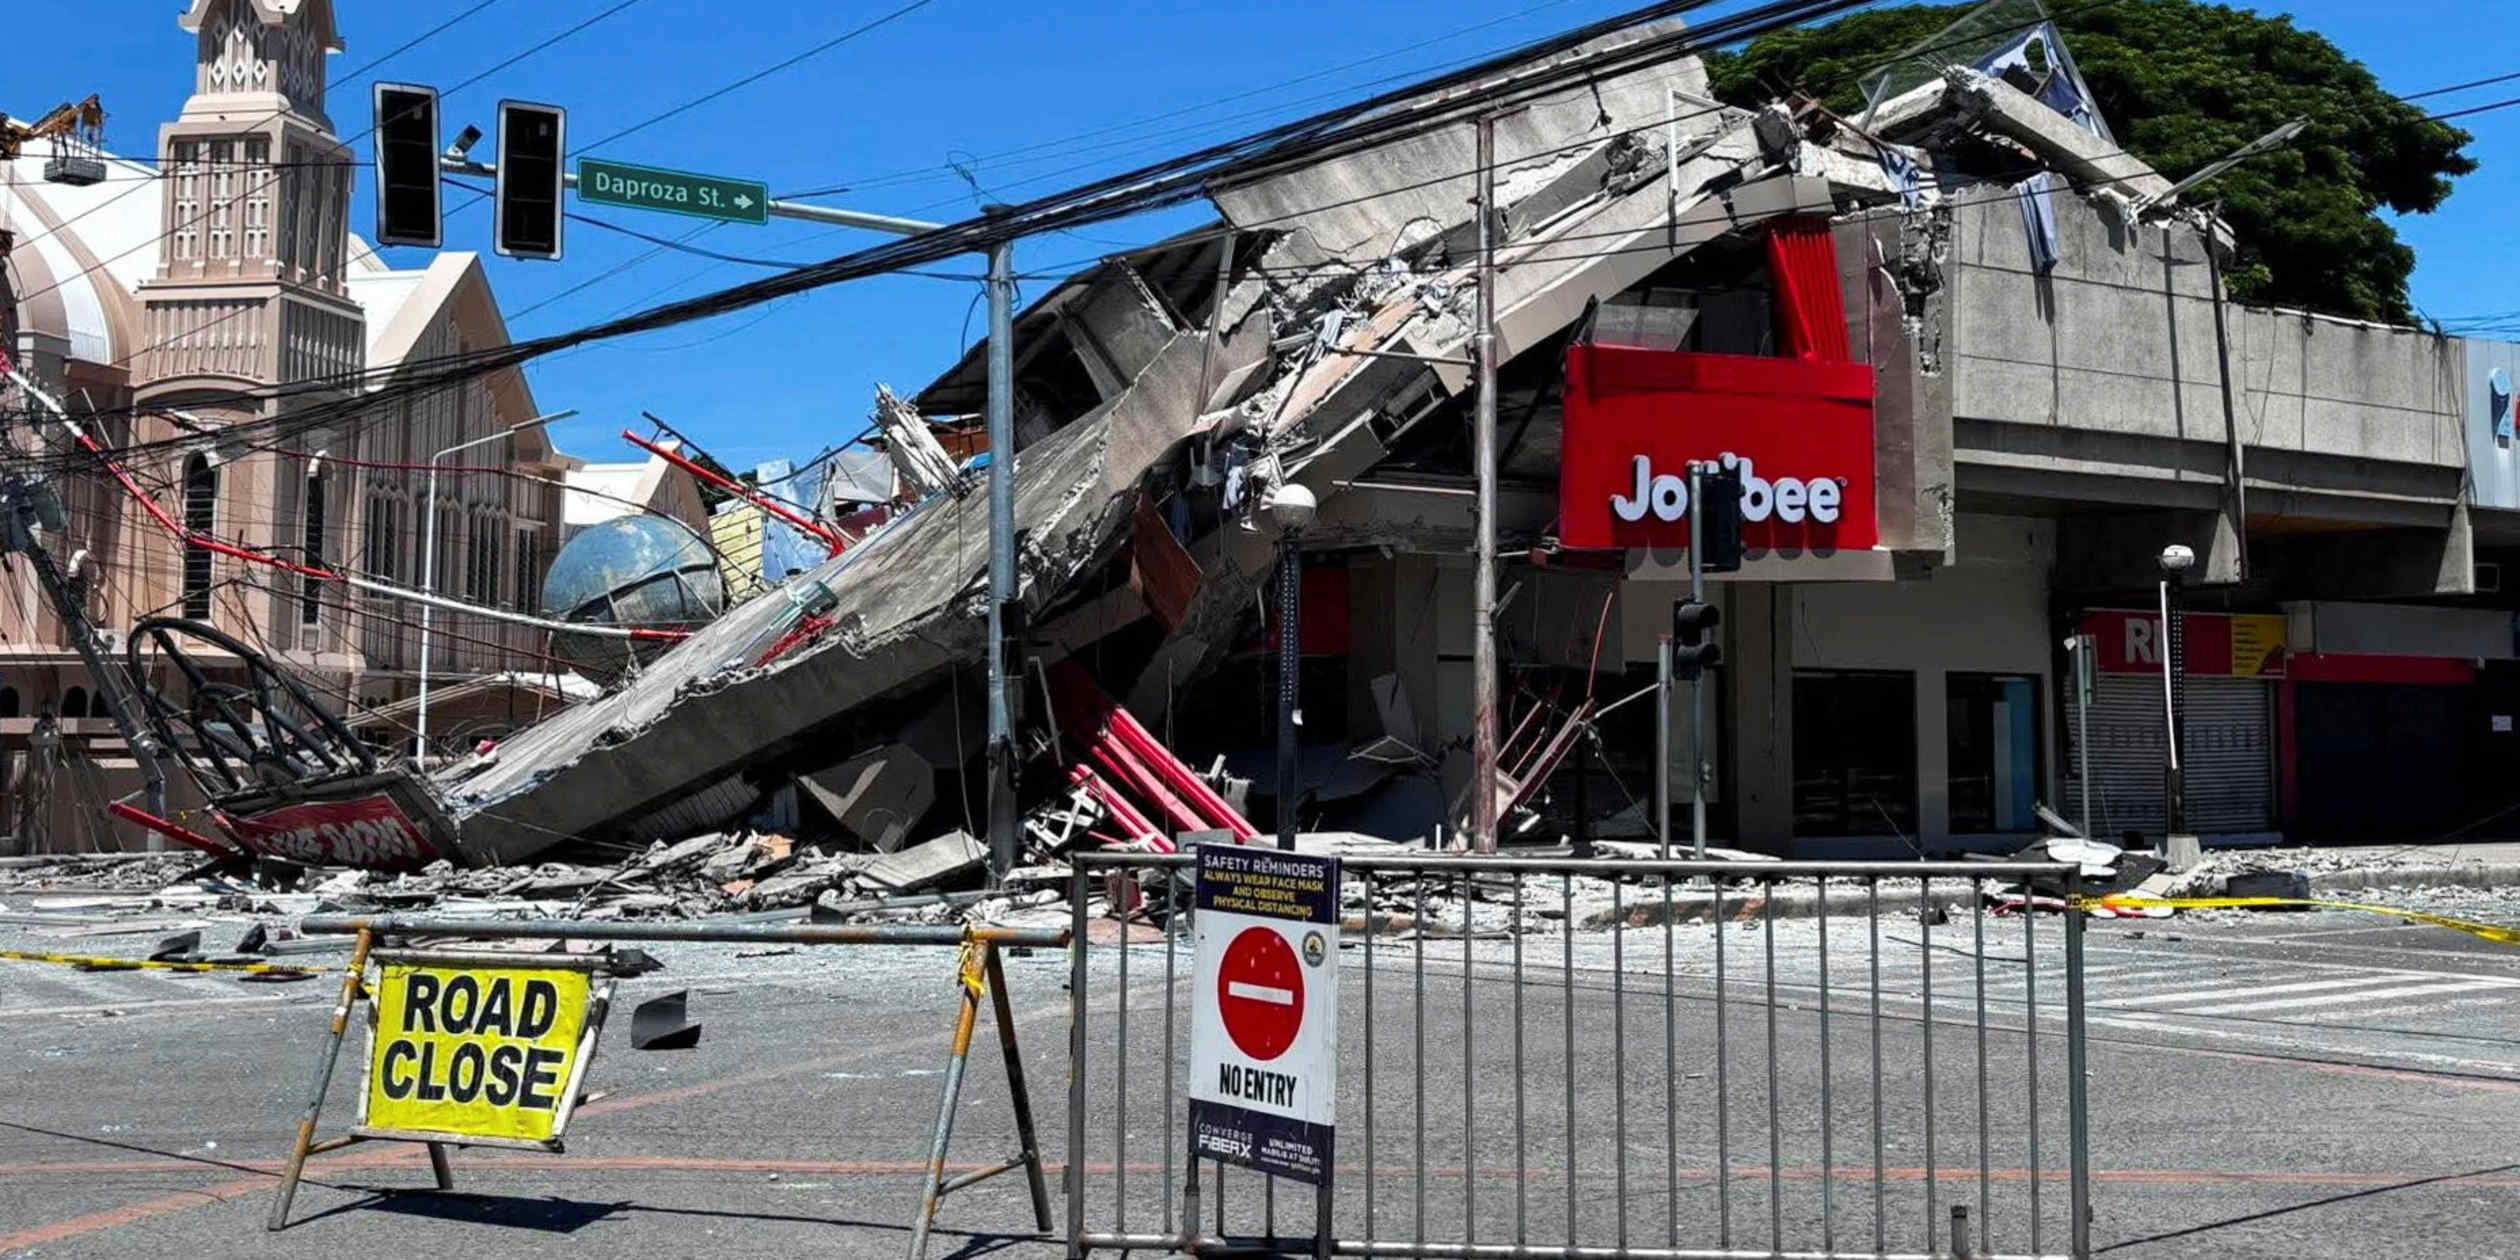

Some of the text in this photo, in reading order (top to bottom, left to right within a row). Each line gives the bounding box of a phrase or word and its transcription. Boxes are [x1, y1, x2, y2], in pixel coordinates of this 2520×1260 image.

[596, 172, 726, 208] Daproza St.
[1203, 854, 1325, 879] SAFETY REMINDERS
[1203, 869, 1325, 892] ALWAYS WEAR FACE MASK
[1232, 885, 1296, 902] AND OBSERVE
[1213, 895, 1313, 917] PHYSICAL DISTANCING
[402, 974, 558, 1039] ROAD
[381, 1040, 565, 1109] CLOSE
[1219, 1062, 1298, 1108] NO ENTRY
[1199, 1122, 1254, 1144] CONVERGE
[1268, 1138, 1313, 1155] UNLIMITED
